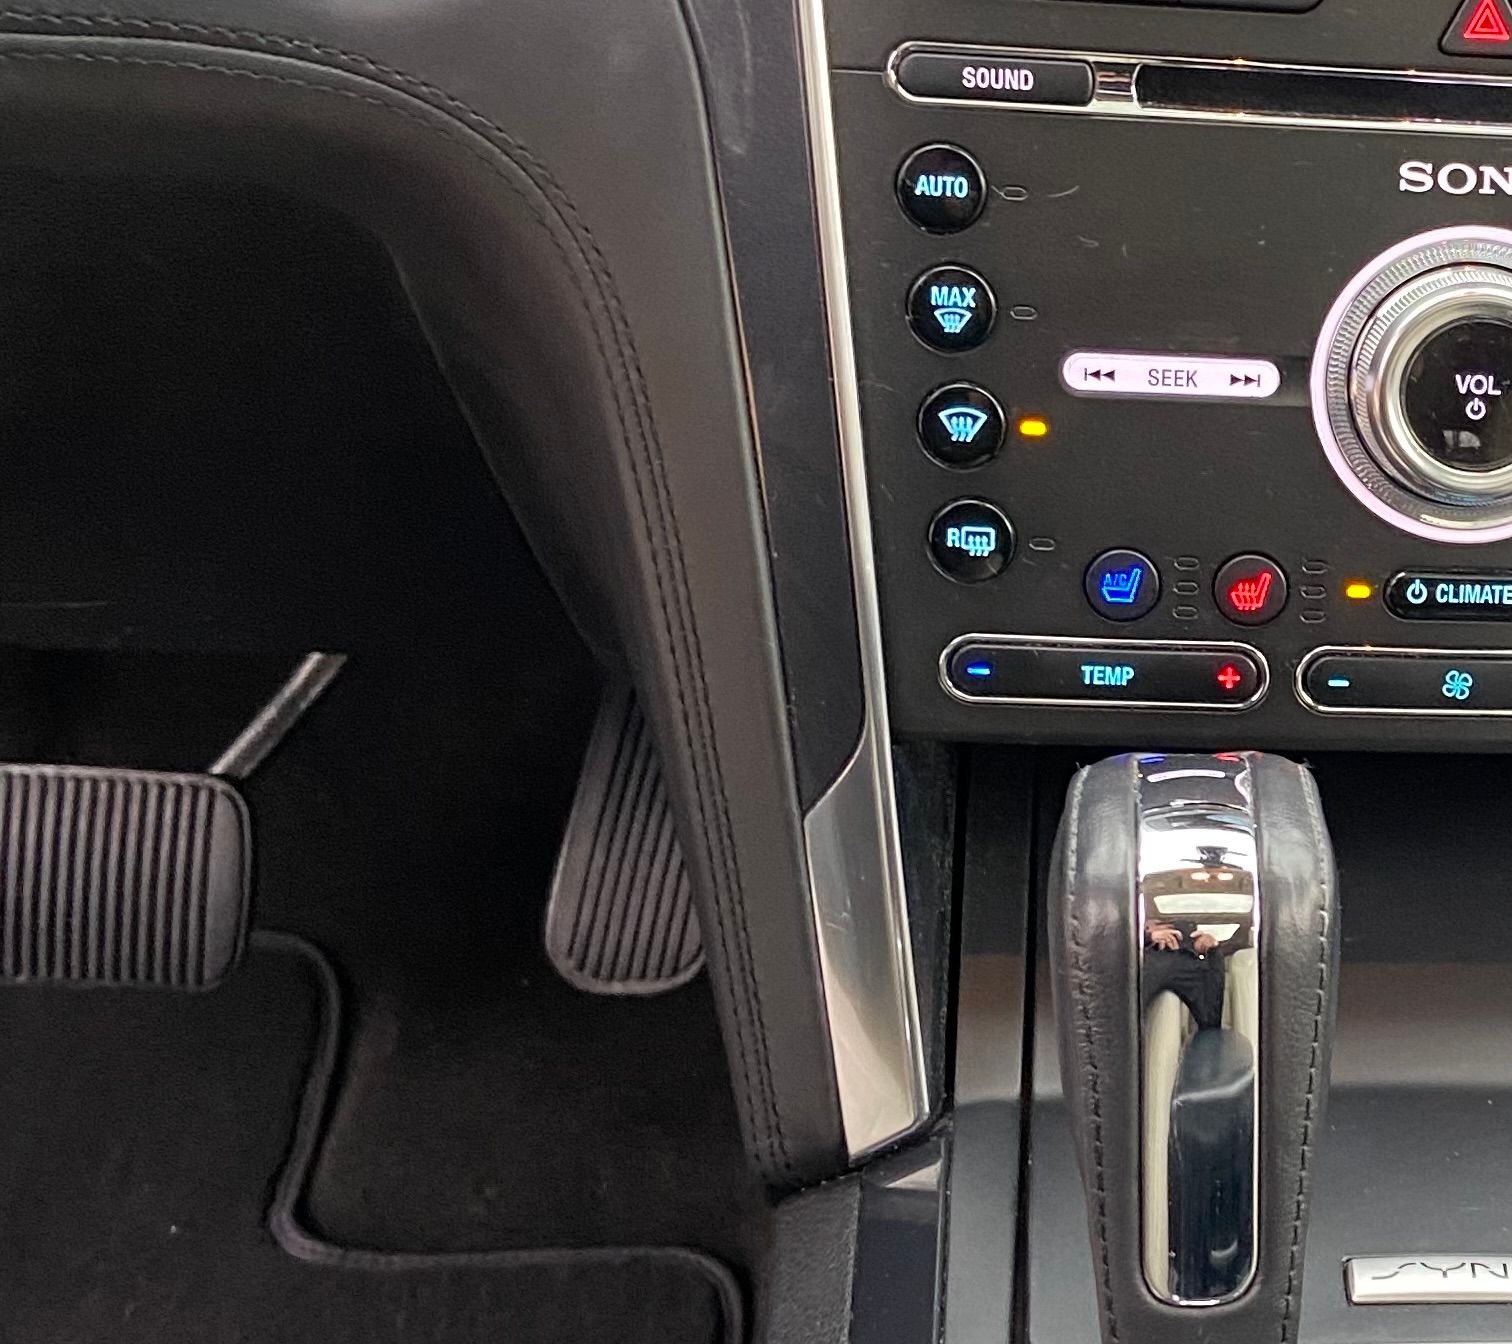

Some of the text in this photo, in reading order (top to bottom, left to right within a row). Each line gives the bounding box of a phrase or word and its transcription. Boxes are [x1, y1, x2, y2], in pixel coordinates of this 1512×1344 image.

[961, 66, 1034, 92] SOUND
[914, 175, 969, 199] AUTO
[930, 285, 976, 308] MAX
[1147, 368, 1198, 388] SEEK
[1455, 374, 1502, 396] VOL
[1081, 665, 1135, 688] TEMP
